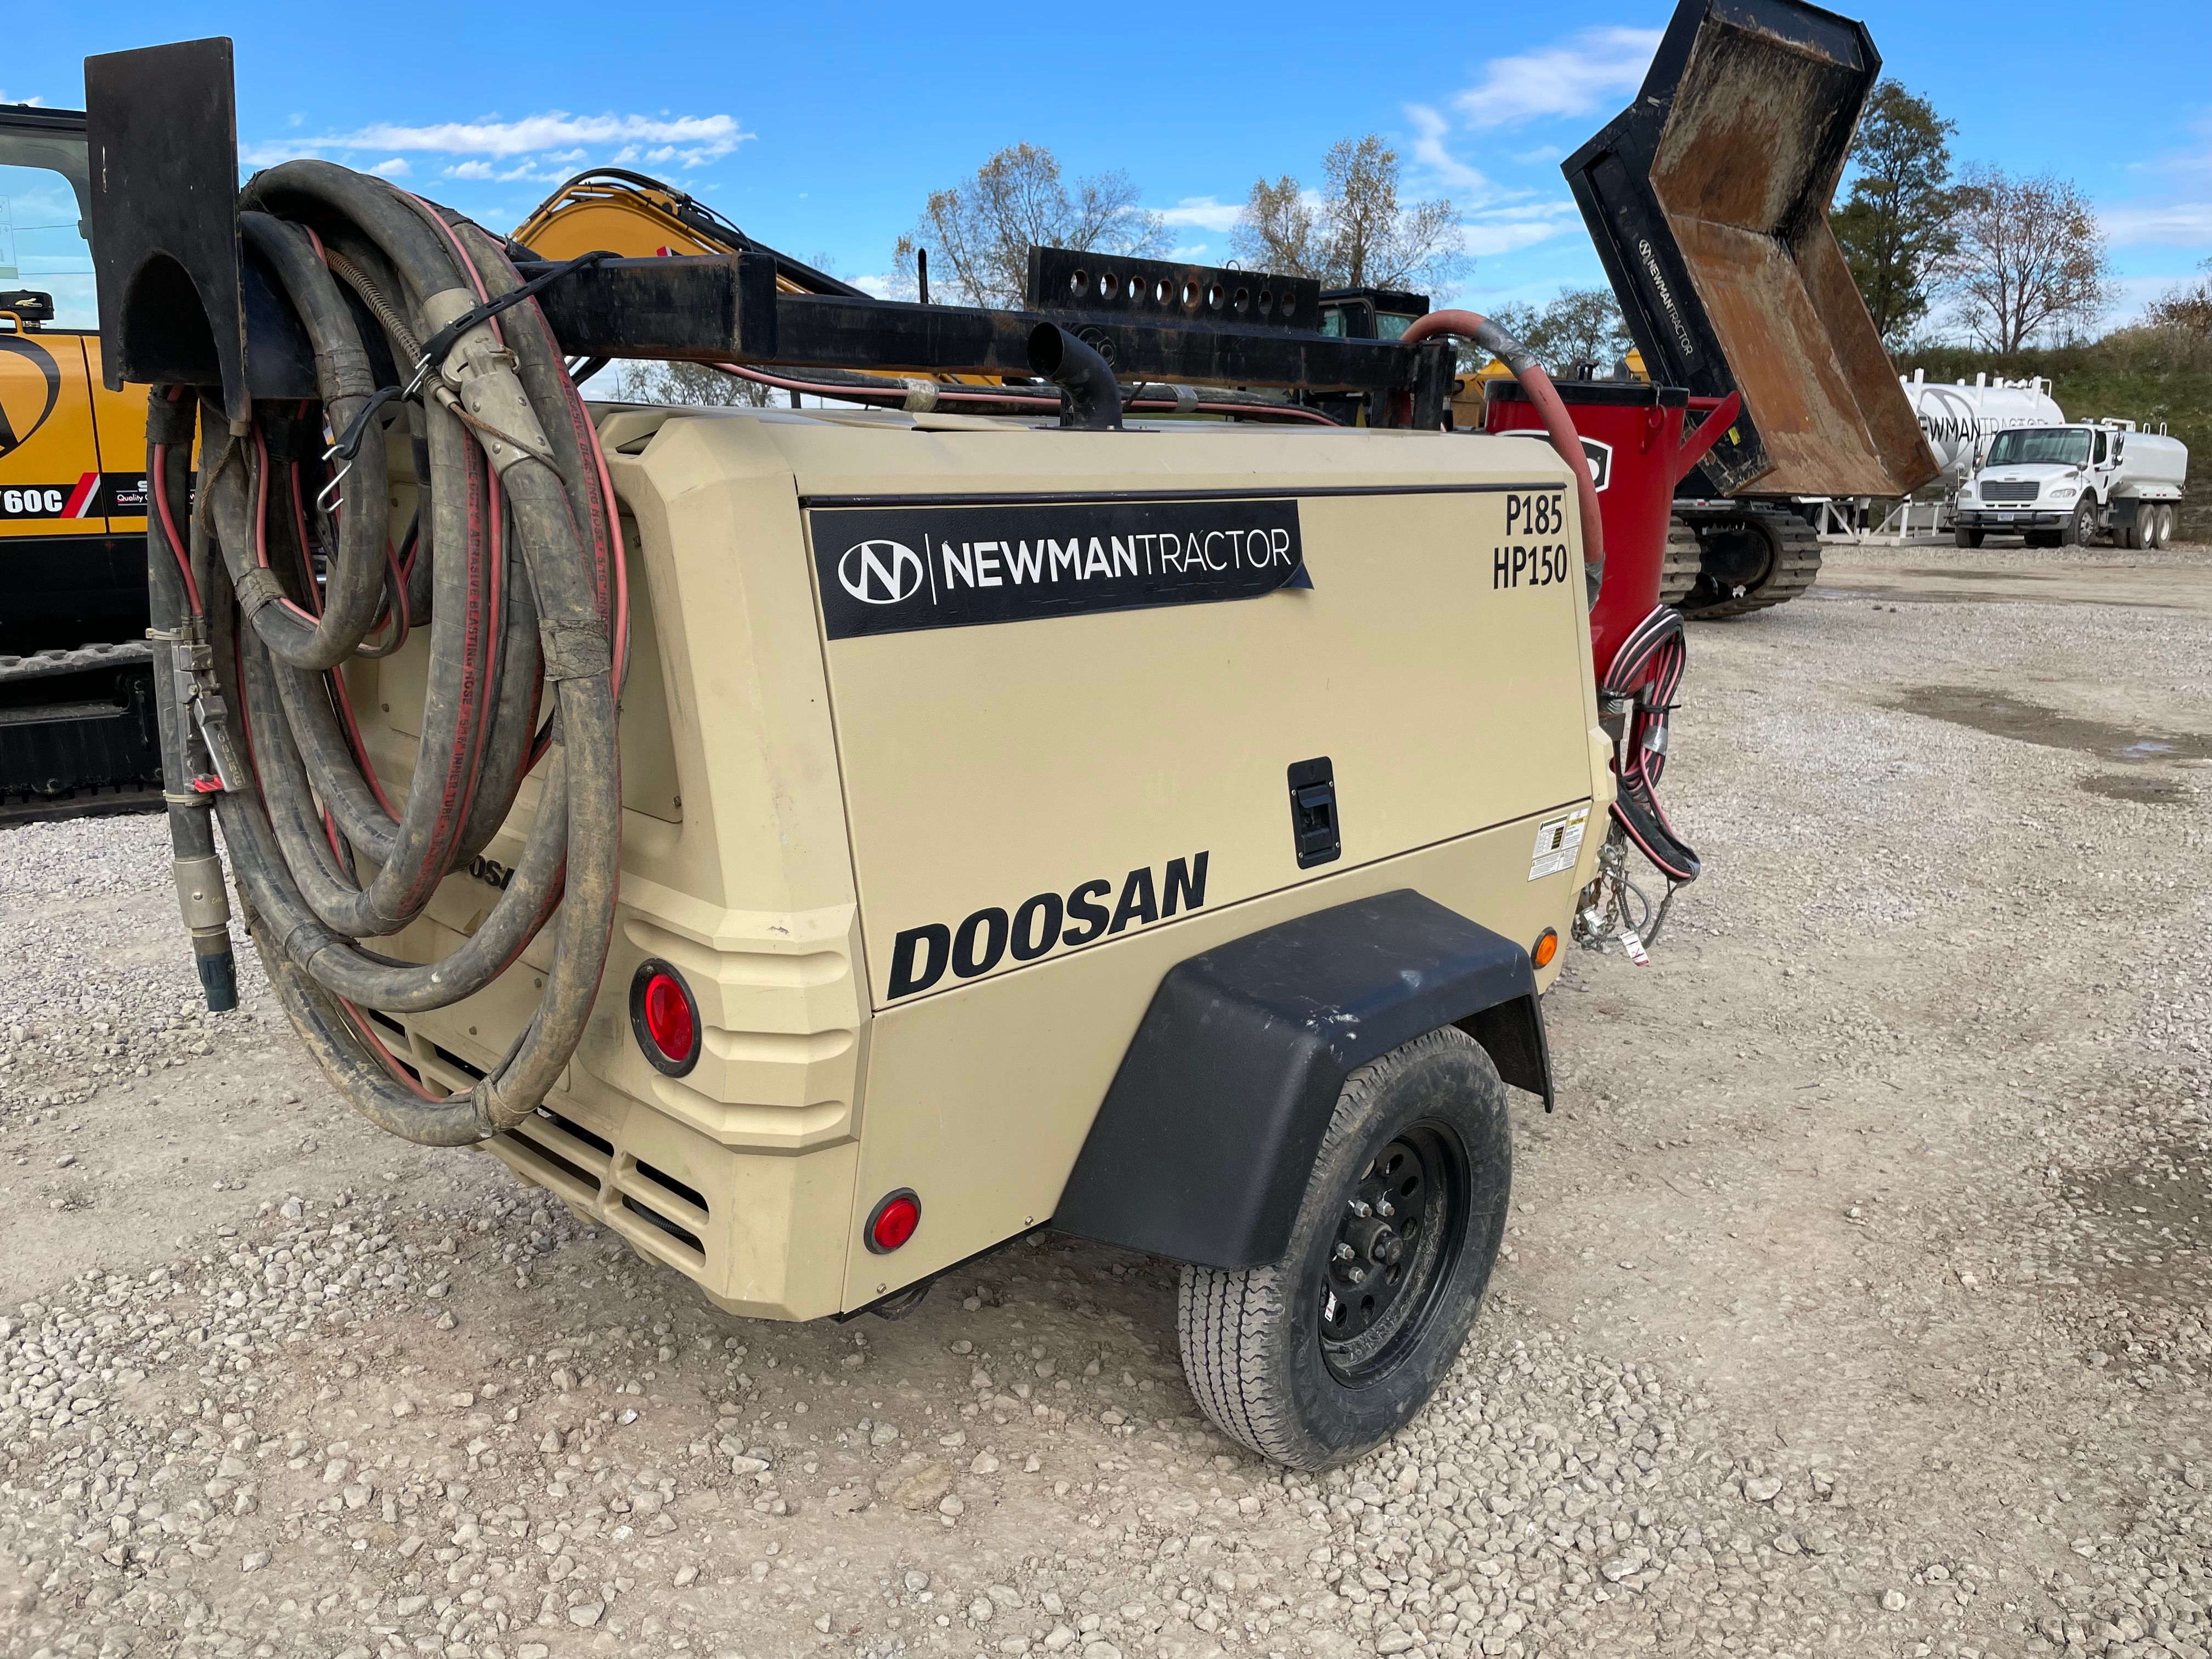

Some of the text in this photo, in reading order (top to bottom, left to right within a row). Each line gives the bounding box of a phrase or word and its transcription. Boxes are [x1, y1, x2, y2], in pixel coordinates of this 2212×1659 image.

[1647, 258, 1693, 356] NEWMANTRACTOR
[0, 490, 63, 513] 60C
[117, 494, 143, 504] Quality
[1506, 494, 1562, 535] P185
[469, 529, 481, 596] ABRASIVE
[944, 529, 1291, 590] NEWMANTRACTOR
[1493, 544, 1567, 589] HP150
[462, 671, 473, 706] HOSE
[448, 752, 464, 788] INNER
[440, 792, 456, 823] TUBE
[887, 850, 1209, 1001] DOOSAN
